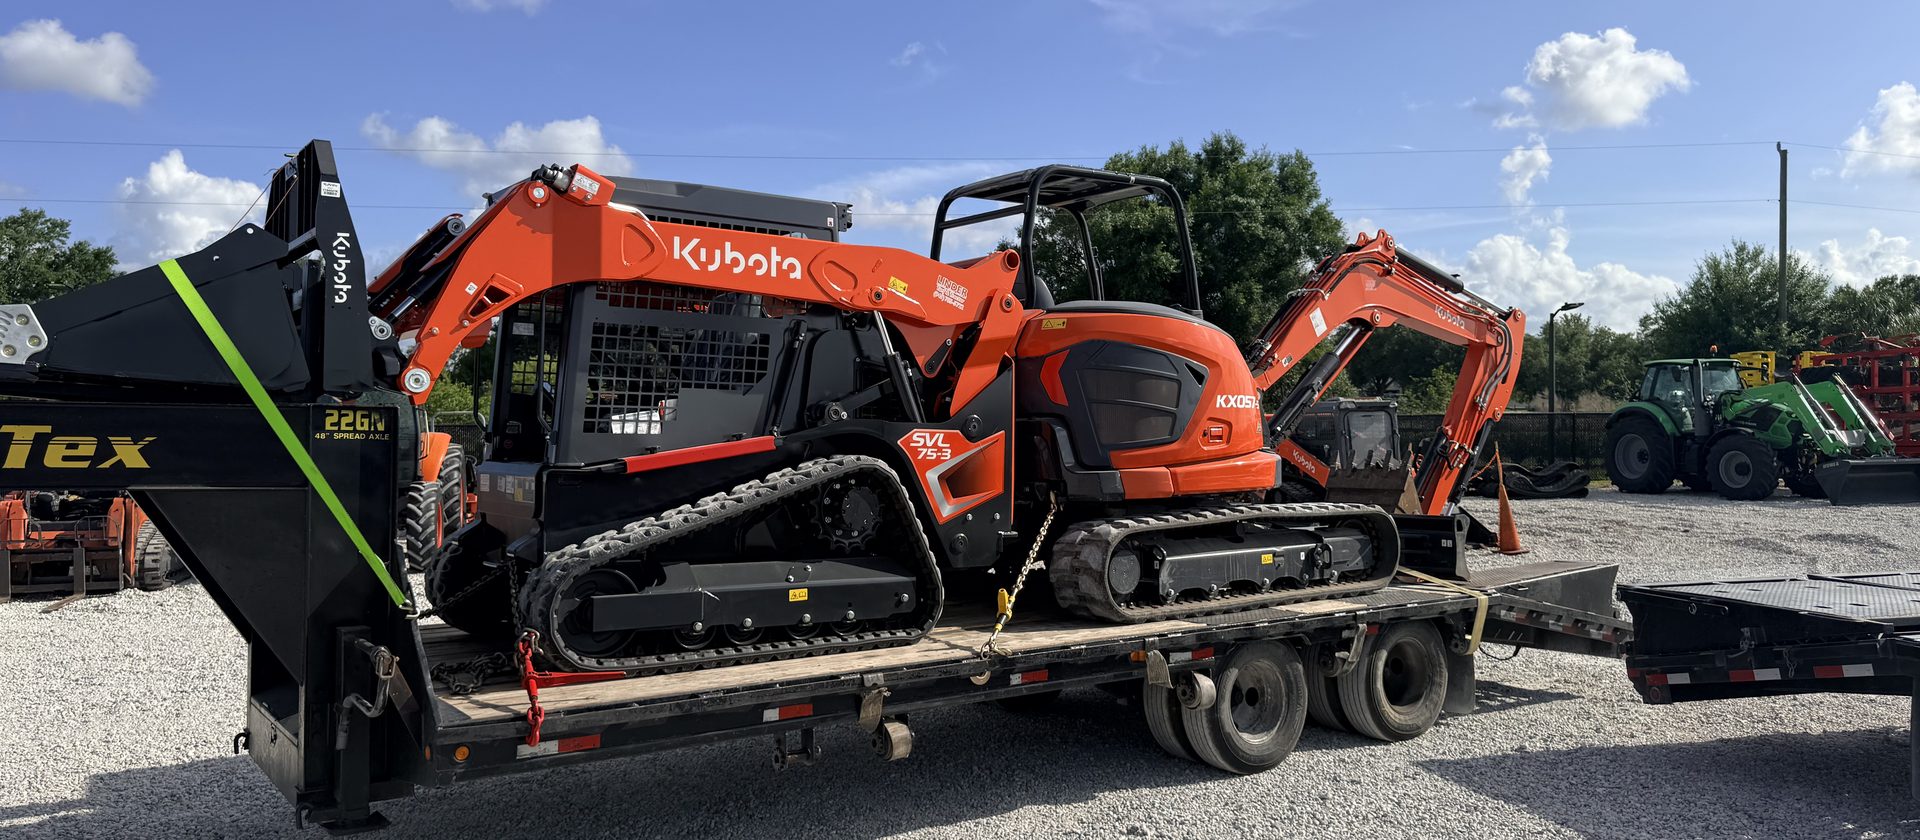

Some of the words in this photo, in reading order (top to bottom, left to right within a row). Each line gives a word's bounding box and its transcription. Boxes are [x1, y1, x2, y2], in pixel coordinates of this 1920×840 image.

[332, 232, 352, 303] Kubota
[673, 235, 802, 280] Kubota
[937, 274, 968, 299] LINDER
[1435, 304, 1465, 329] Kubota
[324, 409, 386, 432] 22GN
[0, 424, 158, 469] Tex
[314, 432, 331, 440] 48"
[333, 432, 367, 440] SPREAD
[368, 433, 390, 441] AXLE
[909, 432, 951, 447] SVL
[917, 447, 952, 460] 75-3
[1292, 449, 1316, 474] Kubota
